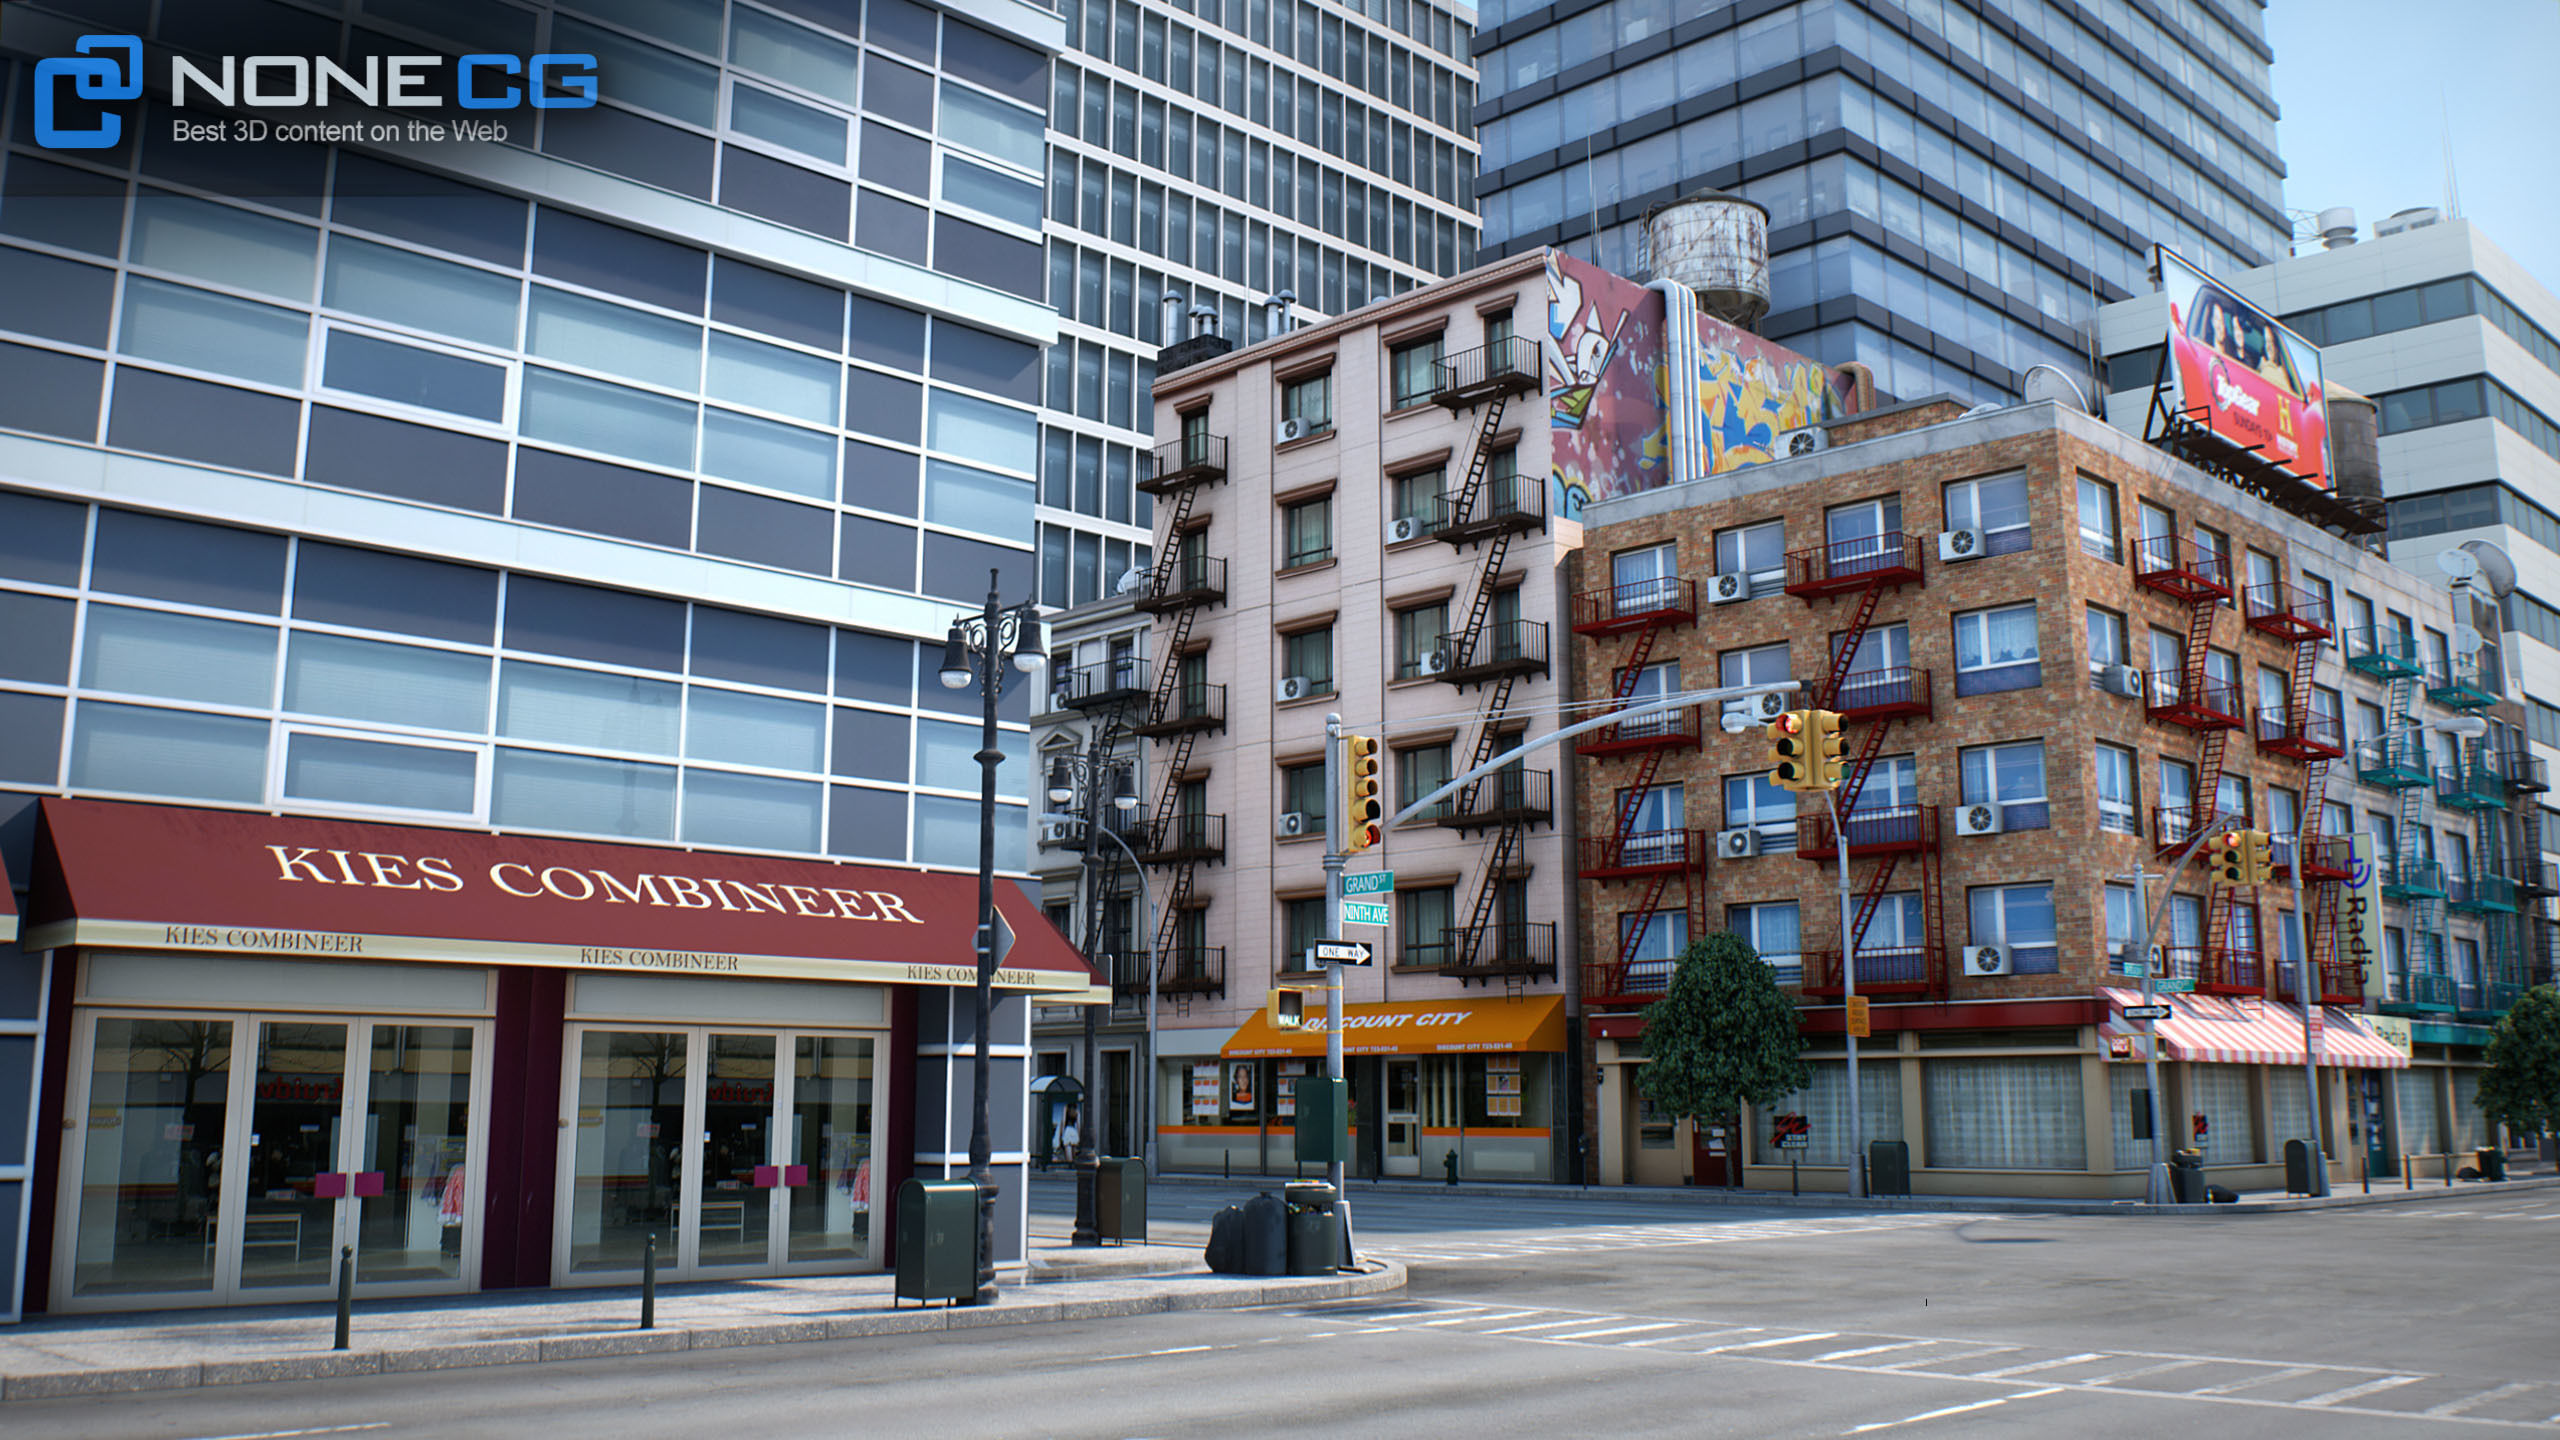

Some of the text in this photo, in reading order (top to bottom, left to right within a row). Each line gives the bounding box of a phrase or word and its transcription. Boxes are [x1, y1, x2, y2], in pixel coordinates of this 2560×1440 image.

[265, 844, 924, 923] KIES COMBINEER
[1346, 875, 1378, 893] GRAND
[1344, 904, 1389, 923] NINTH AVE
[165, 926, 363, 954] KIES COMBINEER
[580, 947, 738, 972] KIES COMBINEER
[1322, 946, 1364, 959] ONE WAY
[907, 964, 1036, 985] KIES COMINEER
[1279, 1013, 1301, 1026] WALK
[1416, 1011, 1472, 1026] CITY
